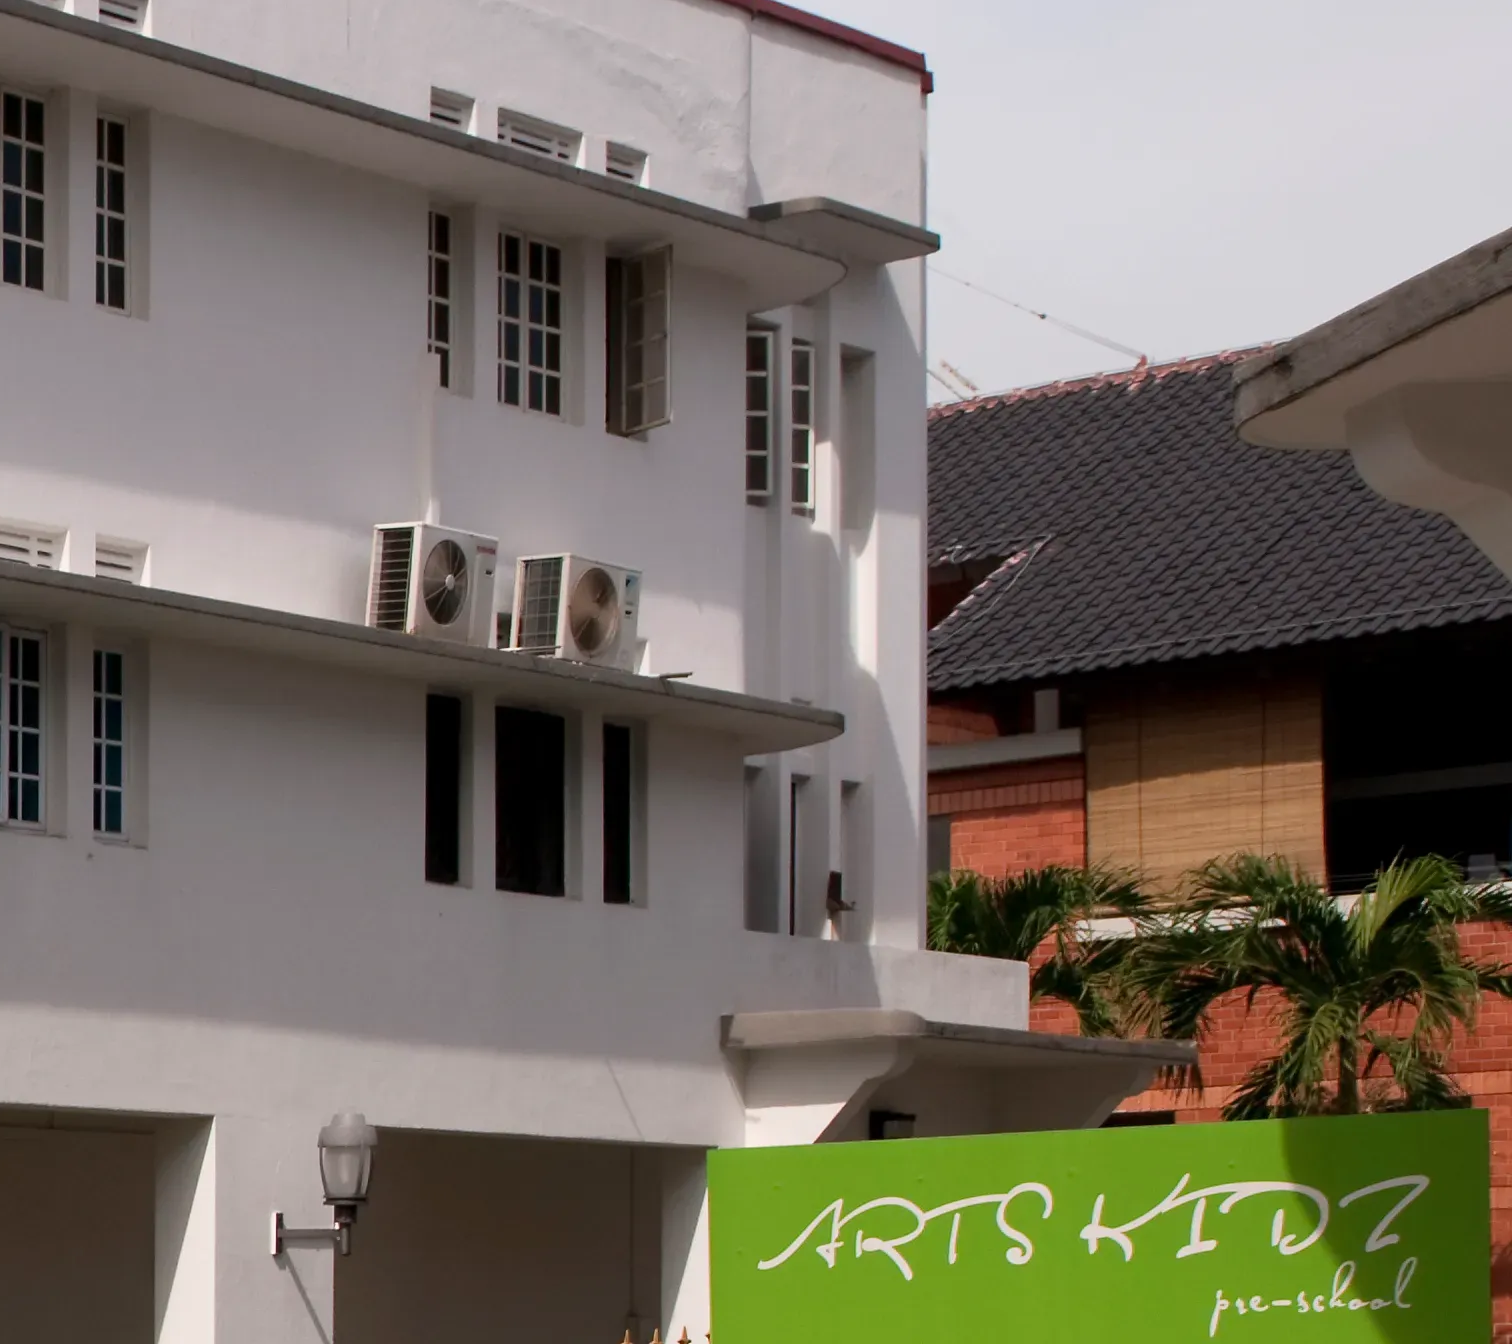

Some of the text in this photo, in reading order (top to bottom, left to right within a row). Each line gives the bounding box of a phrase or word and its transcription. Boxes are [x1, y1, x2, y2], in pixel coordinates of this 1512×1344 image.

[757, 1172, 1431, 1281] ARTS KIDZ
[1208, 1256, 1421, 1338] pre-school
